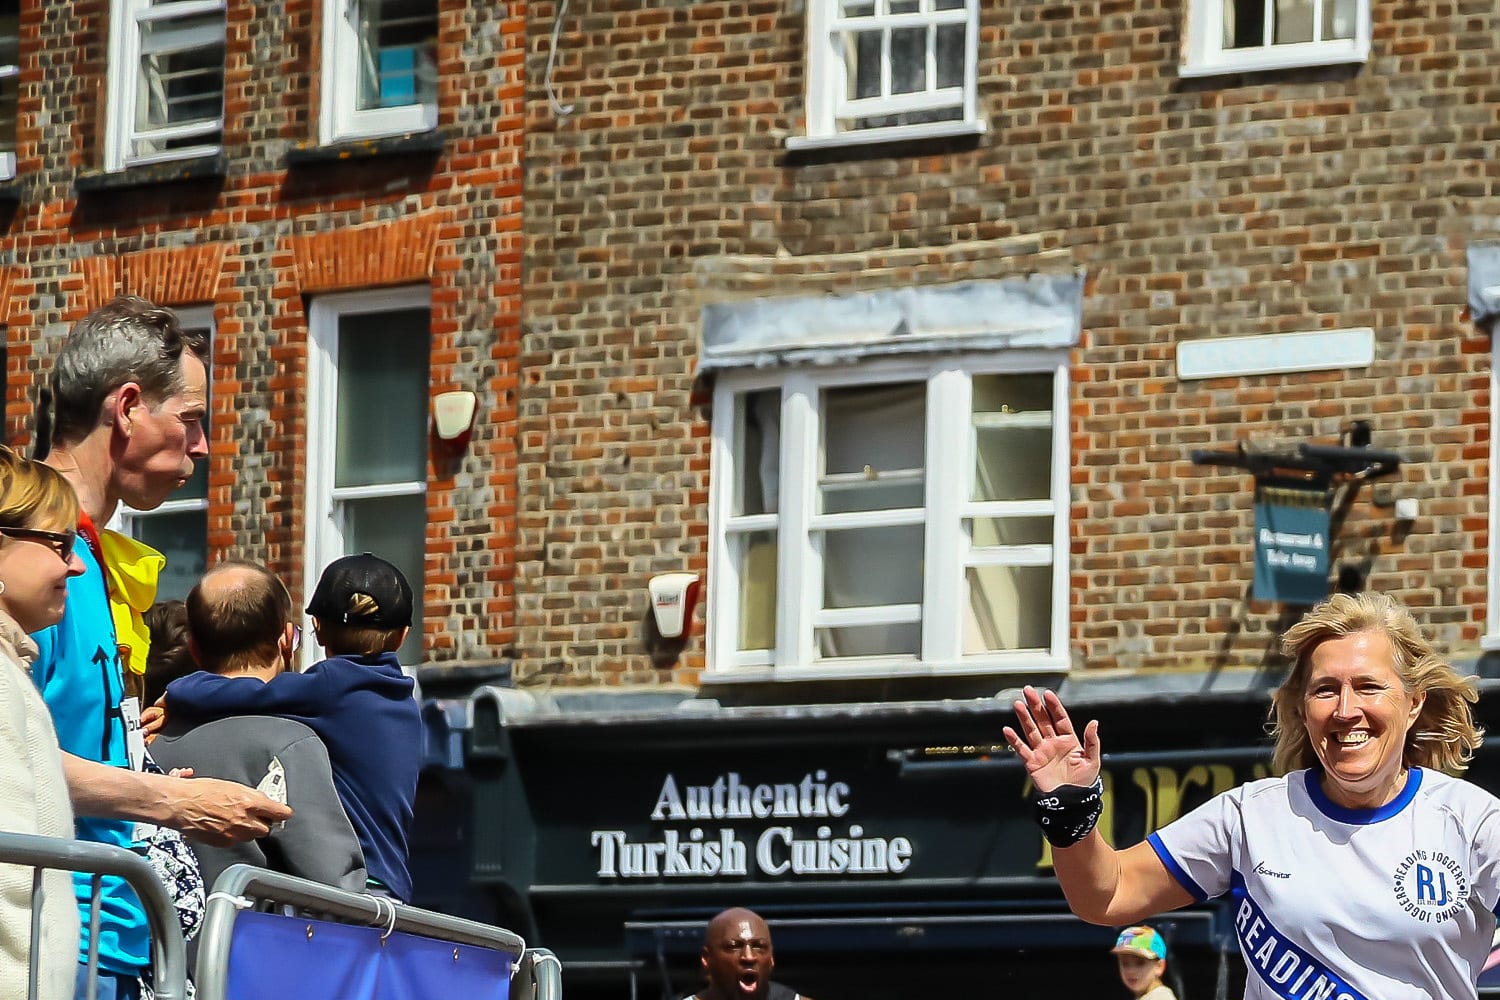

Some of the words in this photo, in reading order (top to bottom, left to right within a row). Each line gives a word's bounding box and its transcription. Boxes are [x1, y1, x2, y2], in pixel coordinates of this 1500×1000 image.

[651, 770, 850, 820] Authentic
[591, 827, 748, 878] Turkish
[755, 824, 913, 876] Cuisine
[1394, 849, 1427, 881] READING
[1431, 851, 1466, 886] JOGGERS
